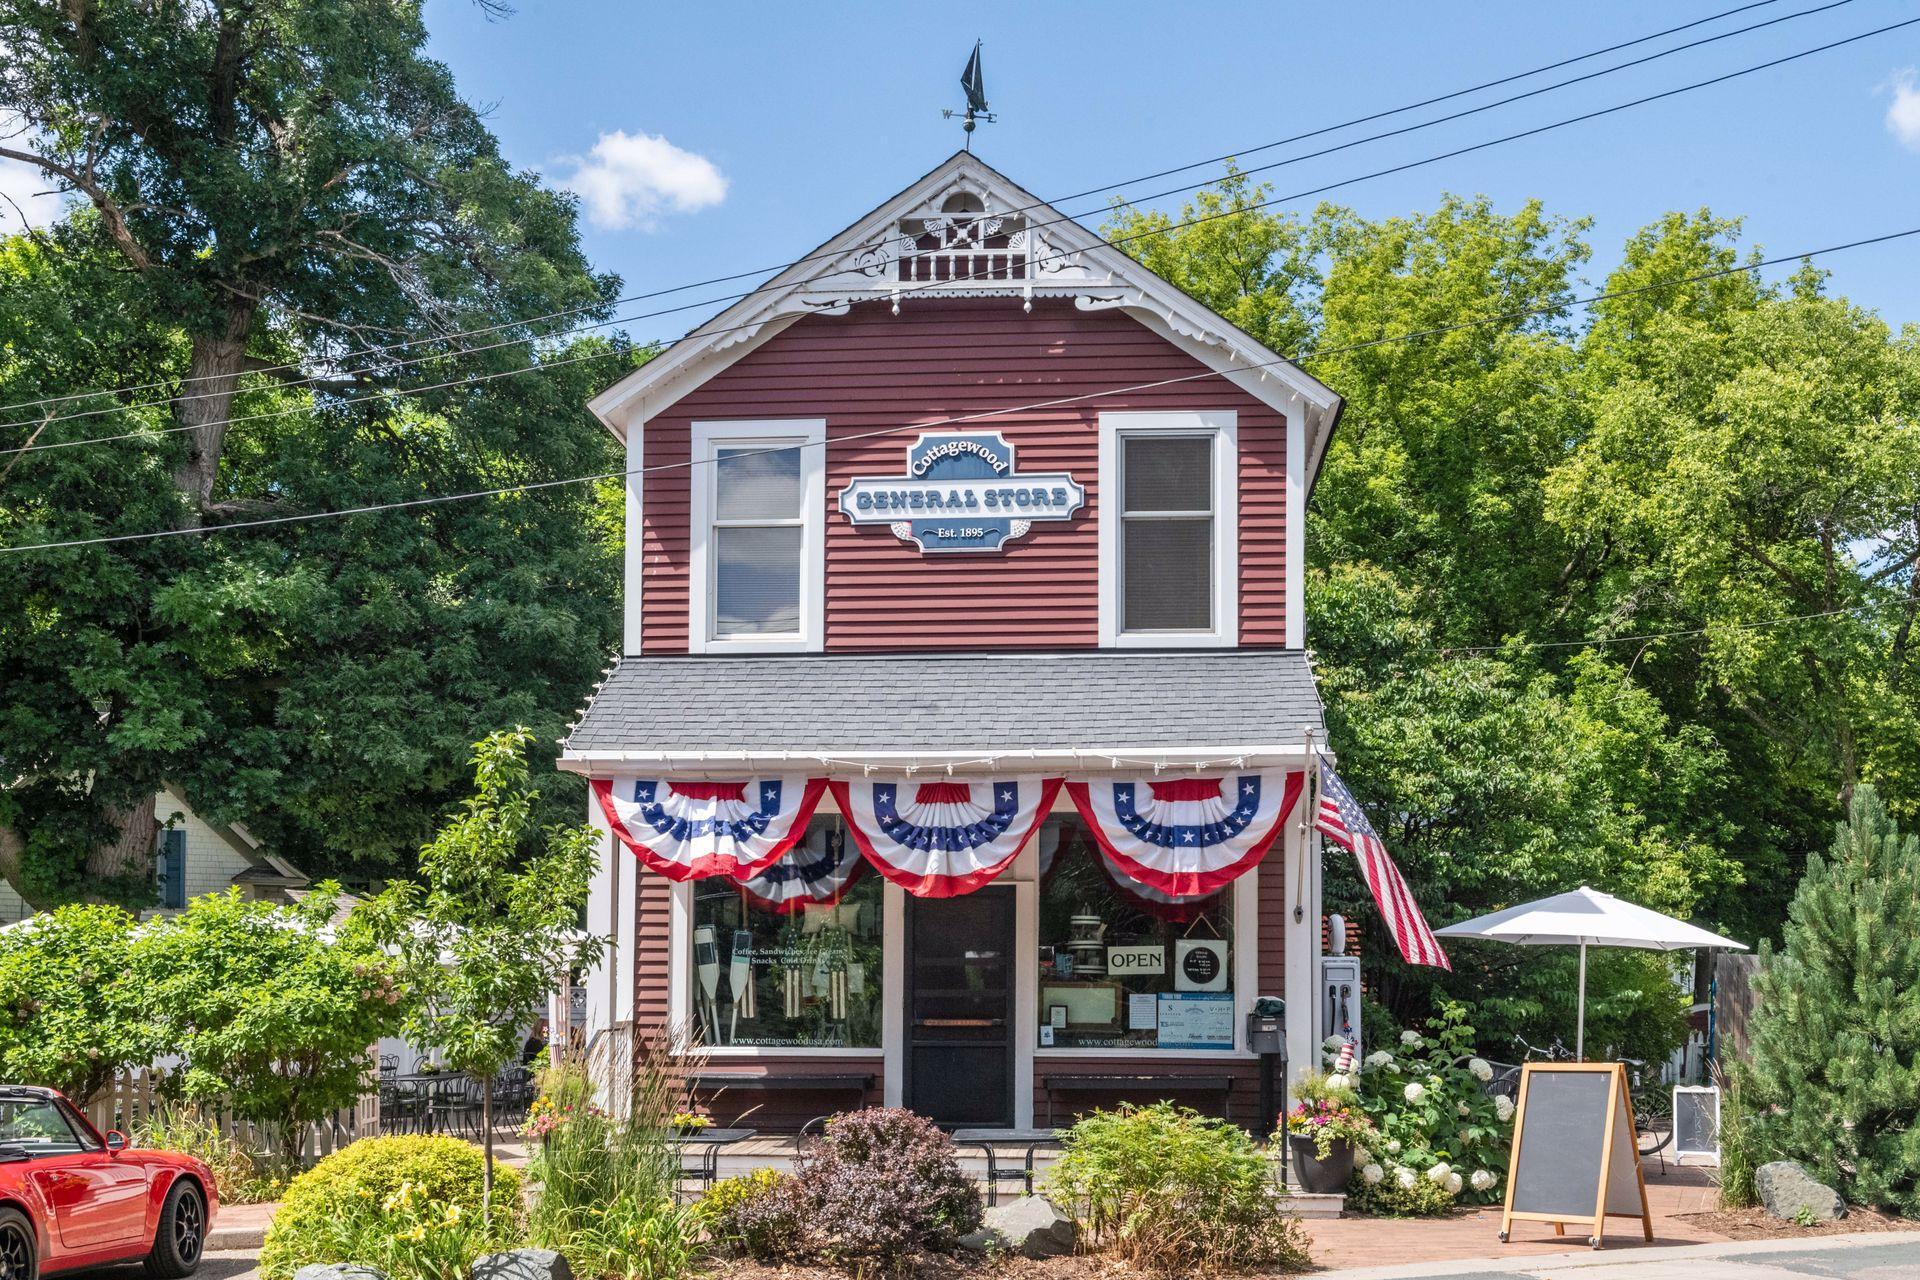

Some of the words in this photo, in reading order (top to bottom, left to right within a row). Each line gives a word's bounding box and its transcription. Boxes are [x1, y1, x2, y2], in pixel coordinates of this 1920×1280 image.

[942, 109, 953, 119] W
[987, 113, 997, 123] E
[912, 440, 1009, 476] Cottagewood
[856, 489, 978, 510] GENERAL
[984, 487, 1068, 508] STORE
[938, 528, 957, 538] Est.
[960, 528, 984, 537] 1895
[1111, 953, 1161, 968] OPEN
[731, 1037, 843, 1046] www.cottagewoodusa.com
